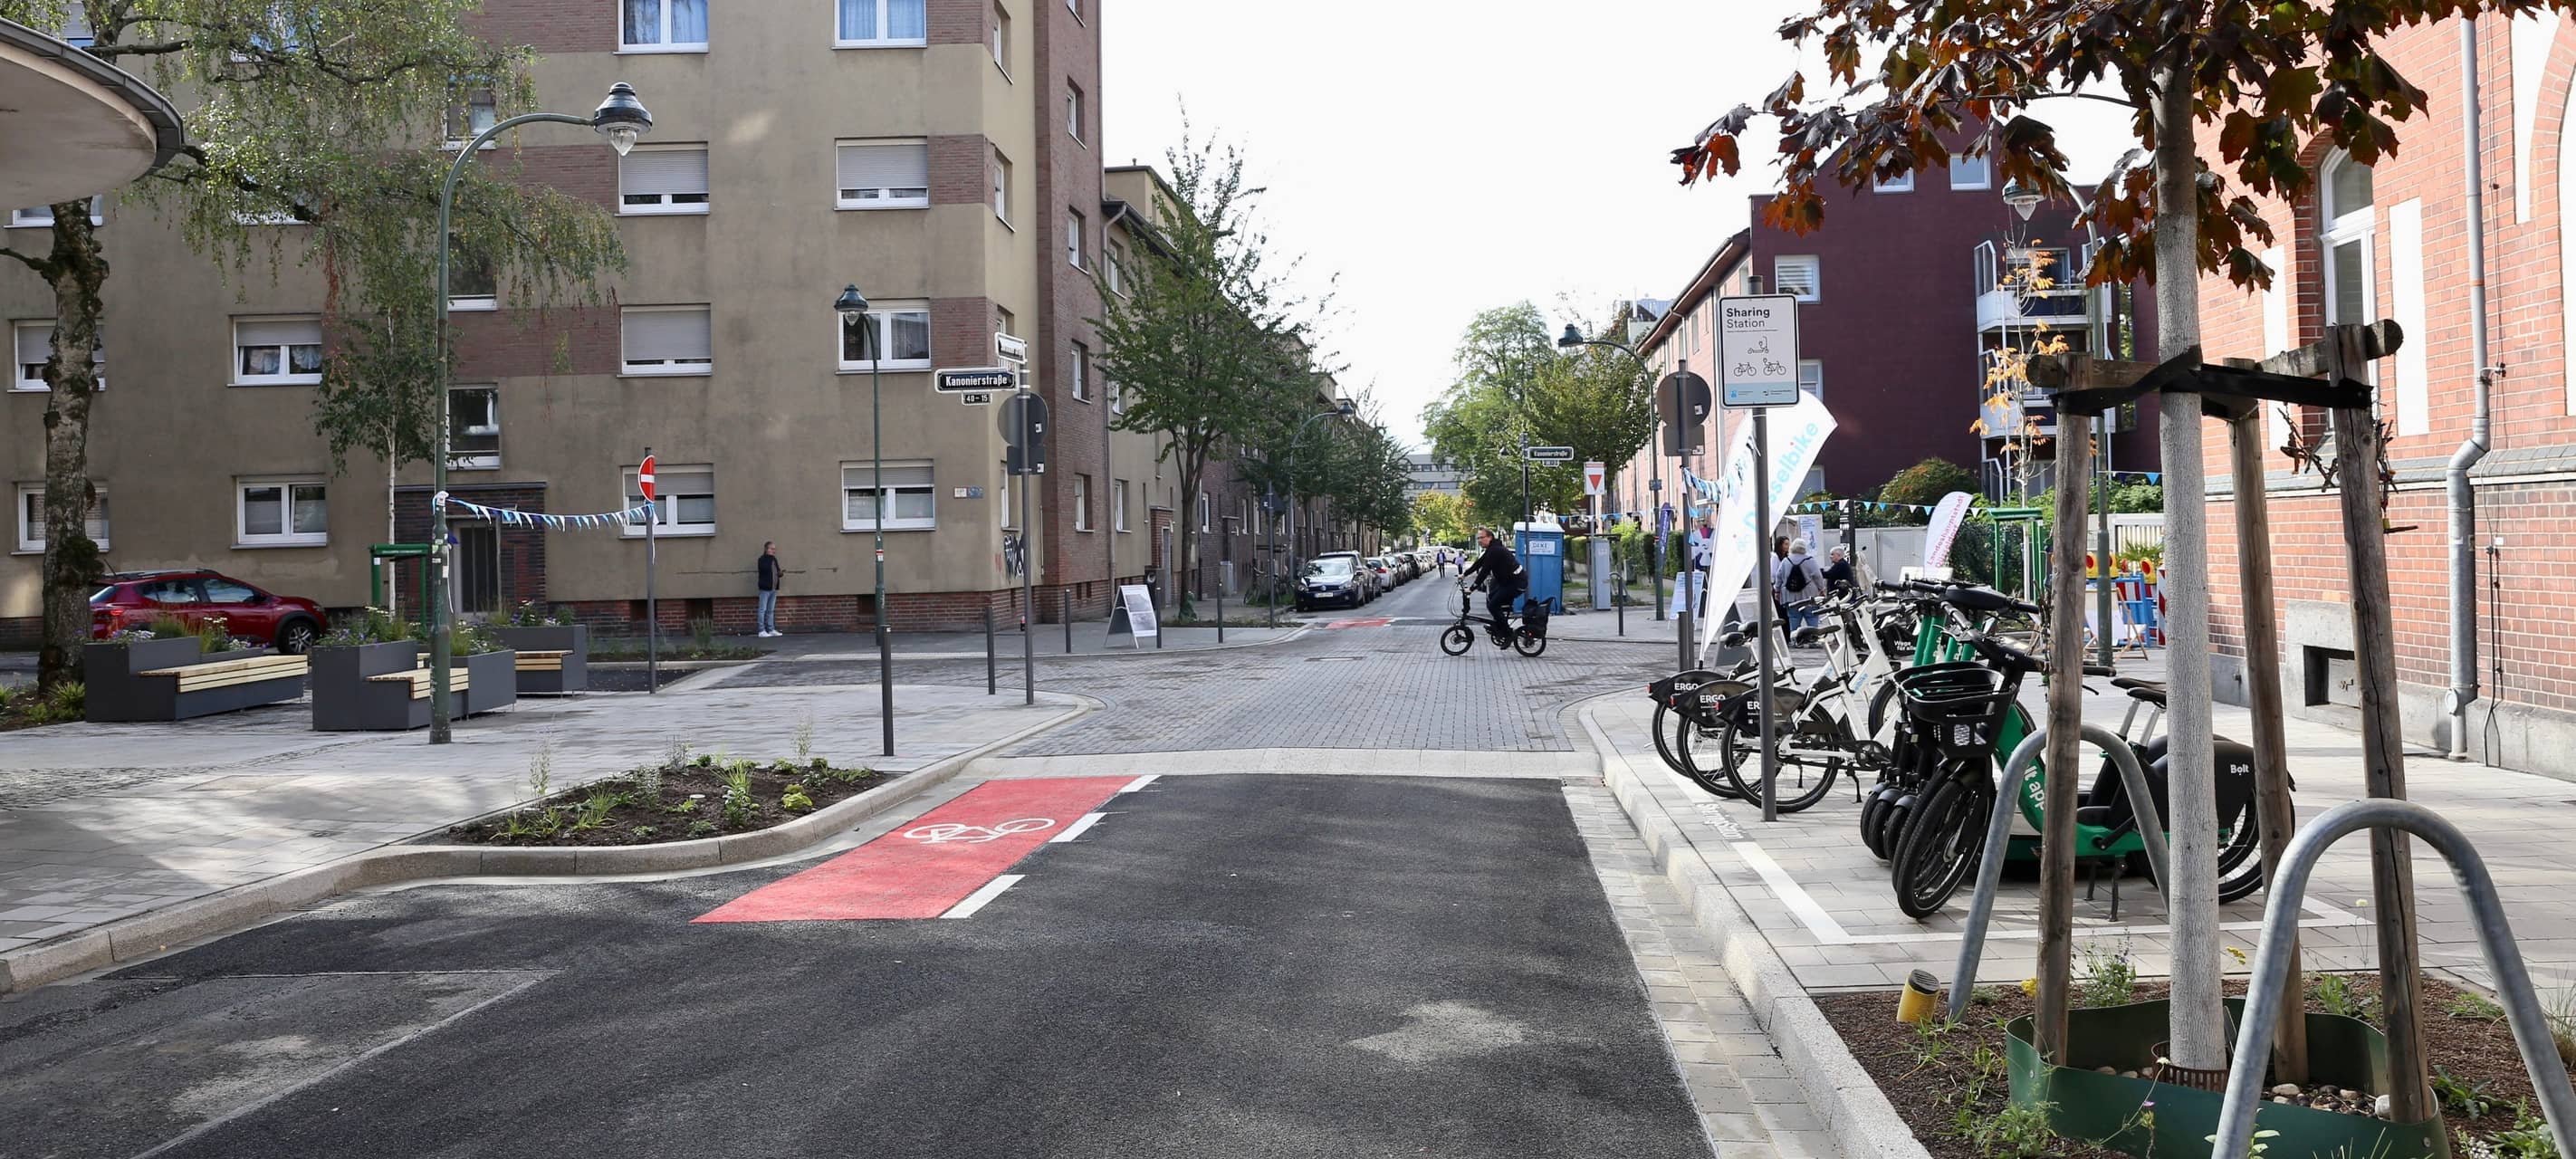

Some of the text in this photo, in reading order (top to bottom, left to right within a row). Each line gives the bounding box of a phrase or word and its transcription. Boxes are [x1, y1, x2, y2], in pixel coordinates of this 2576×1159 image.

[1726, 307, 1770, 319] Sharing
[1727, 318, 1765, 329] Station
[945, 375, 1008, 387] Kanonierstraße
[1674, 683, 1699, 691] ERGO
[1700, 694, 1726, 704] ERGO
[1747, 701, 1760, 710] ER
[2230, 763, 2250, 776] Bolt
